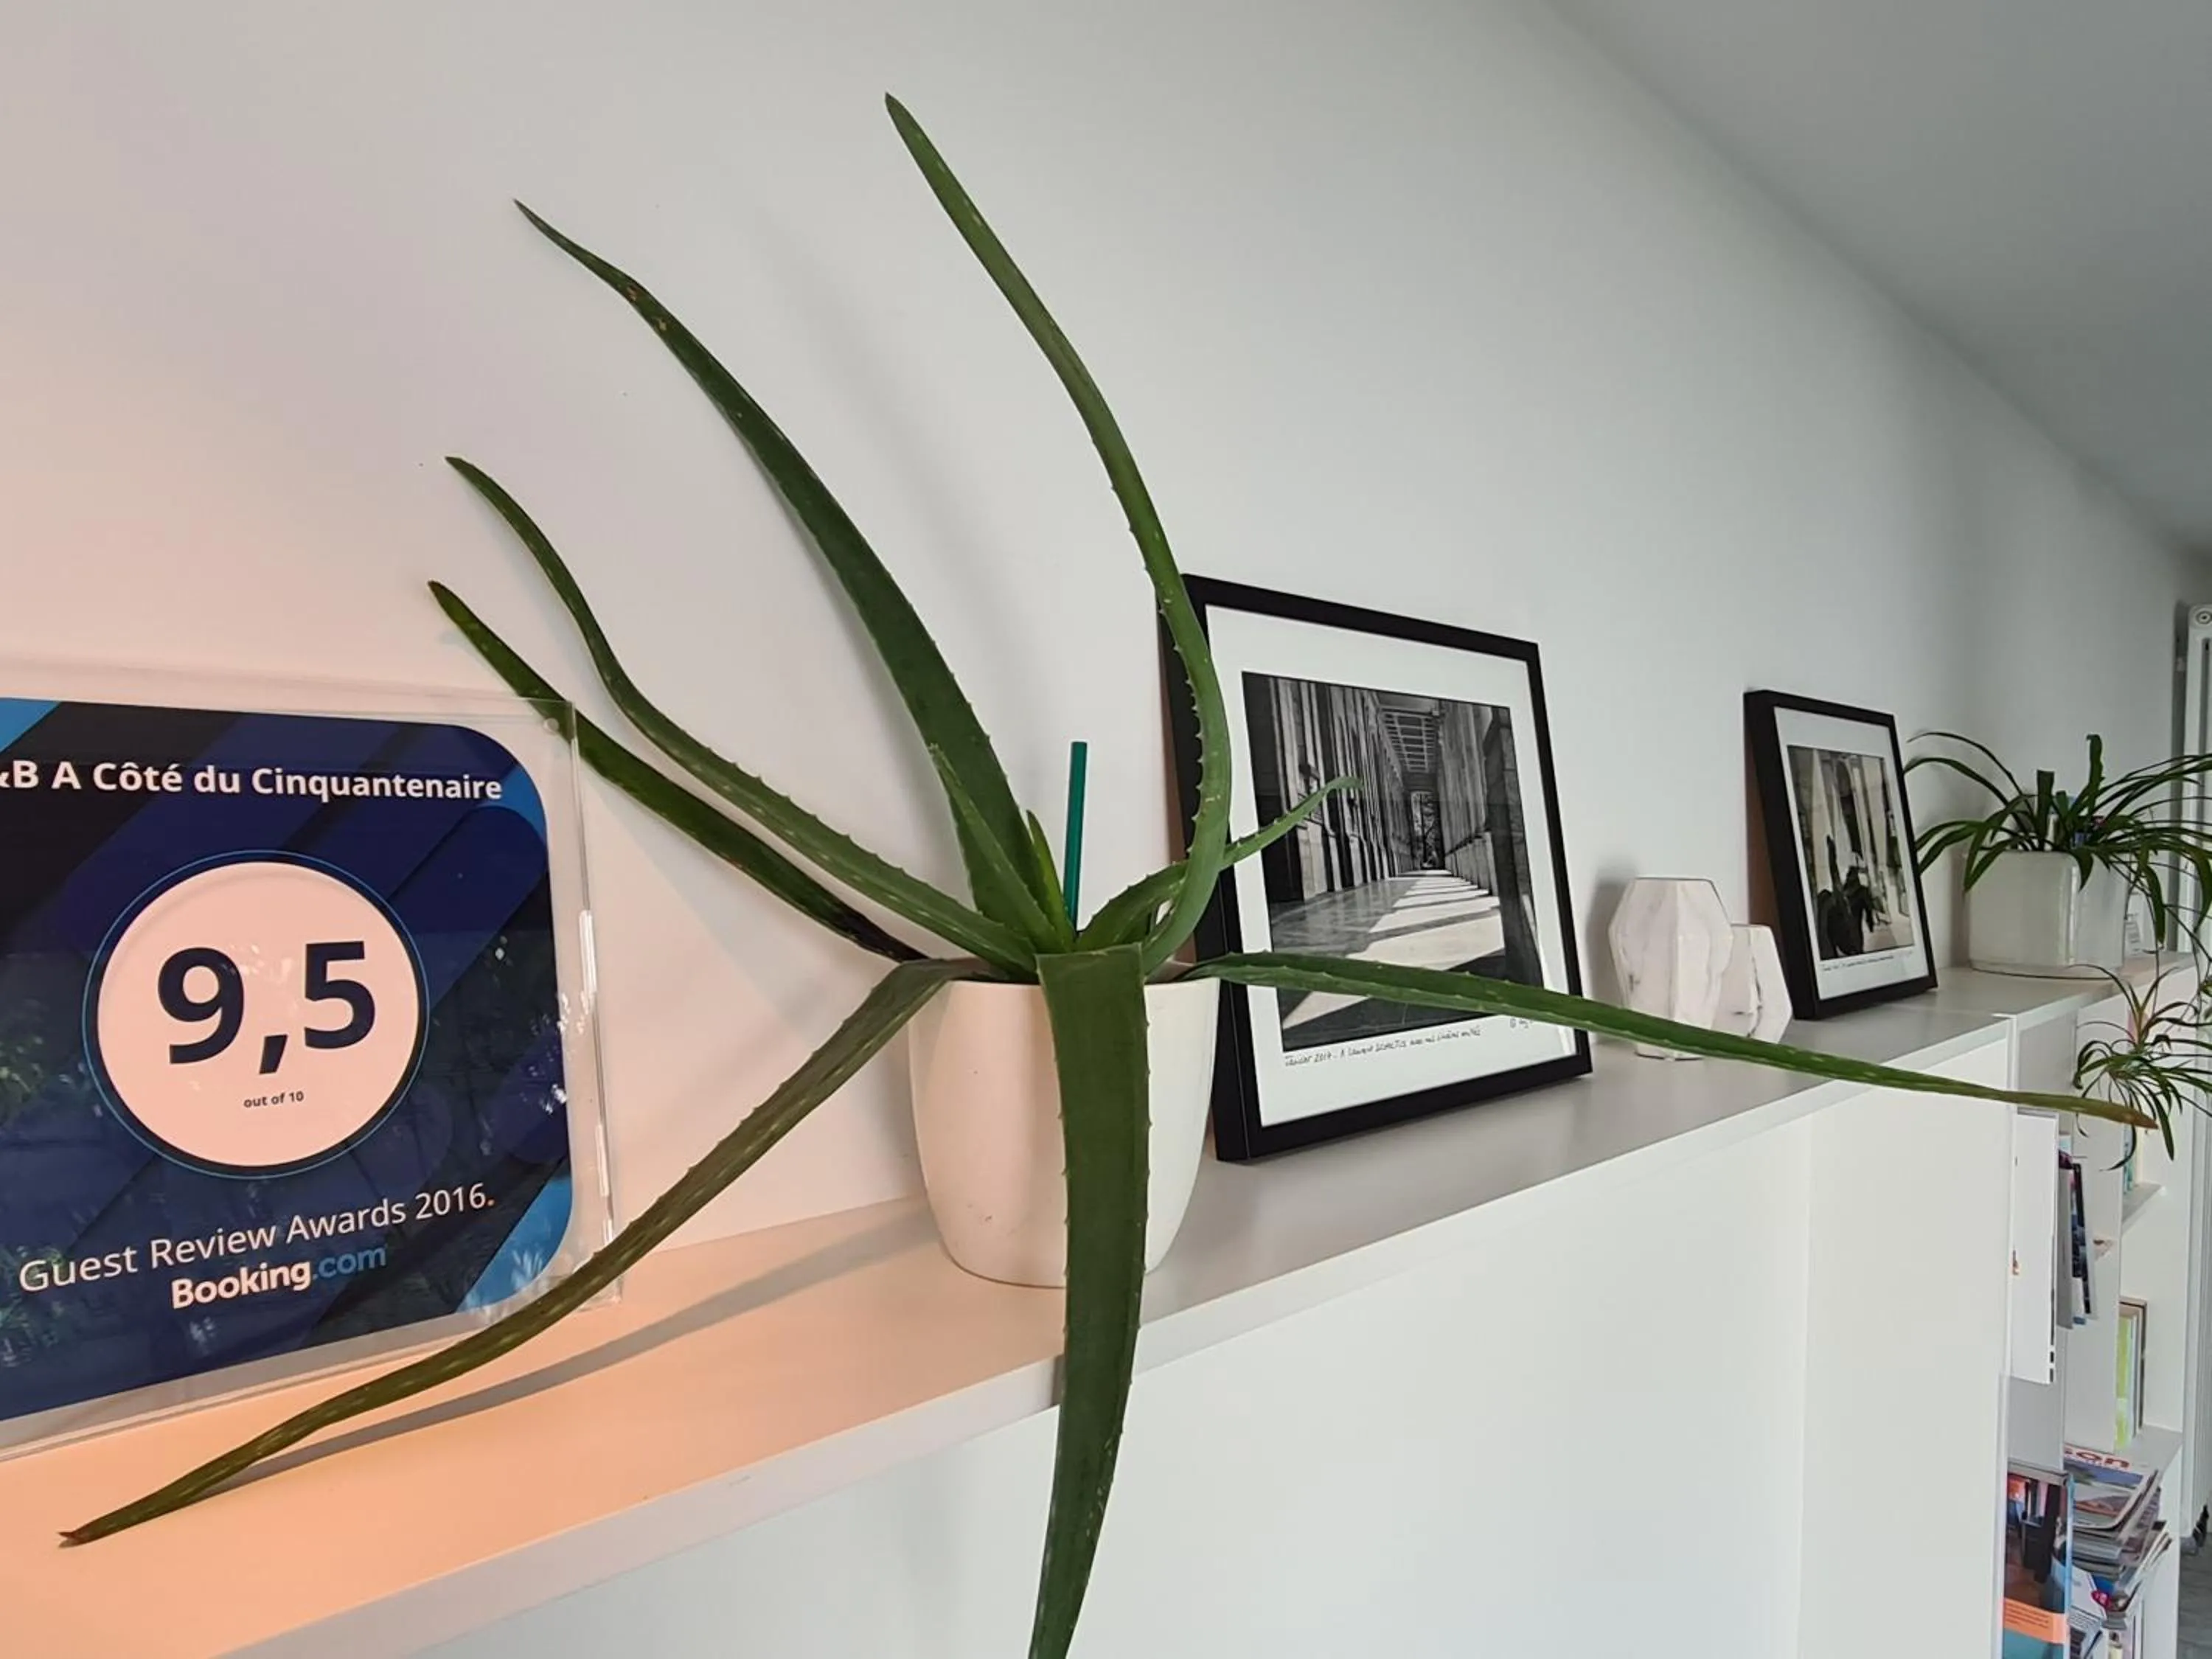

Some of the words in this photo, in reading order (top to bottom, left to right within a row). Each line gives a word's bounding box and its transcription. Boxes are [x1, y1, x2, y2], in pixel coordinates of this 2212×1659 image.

[51, 761, 82, 790] A
[93, 762, 183, 792] Côté
[194, 765, 240, 793] du
[251, 768, 502, 803] Cinquantenaire
[157, 940, 375, 1075] 9,5
[244, 1096, 267, 1107] out
[271, 1093, 285, 1105] of
[290, 1091, 304, 1102] 10
[19, 1246, 138, 1292] Guest
[150, 1225, 276, 1269] Review
[285, 1198, 406, 1244] Awards
[414, 1182, 495, 1220] 2016.
[171, 1246, 386, 1309] Booking.com
